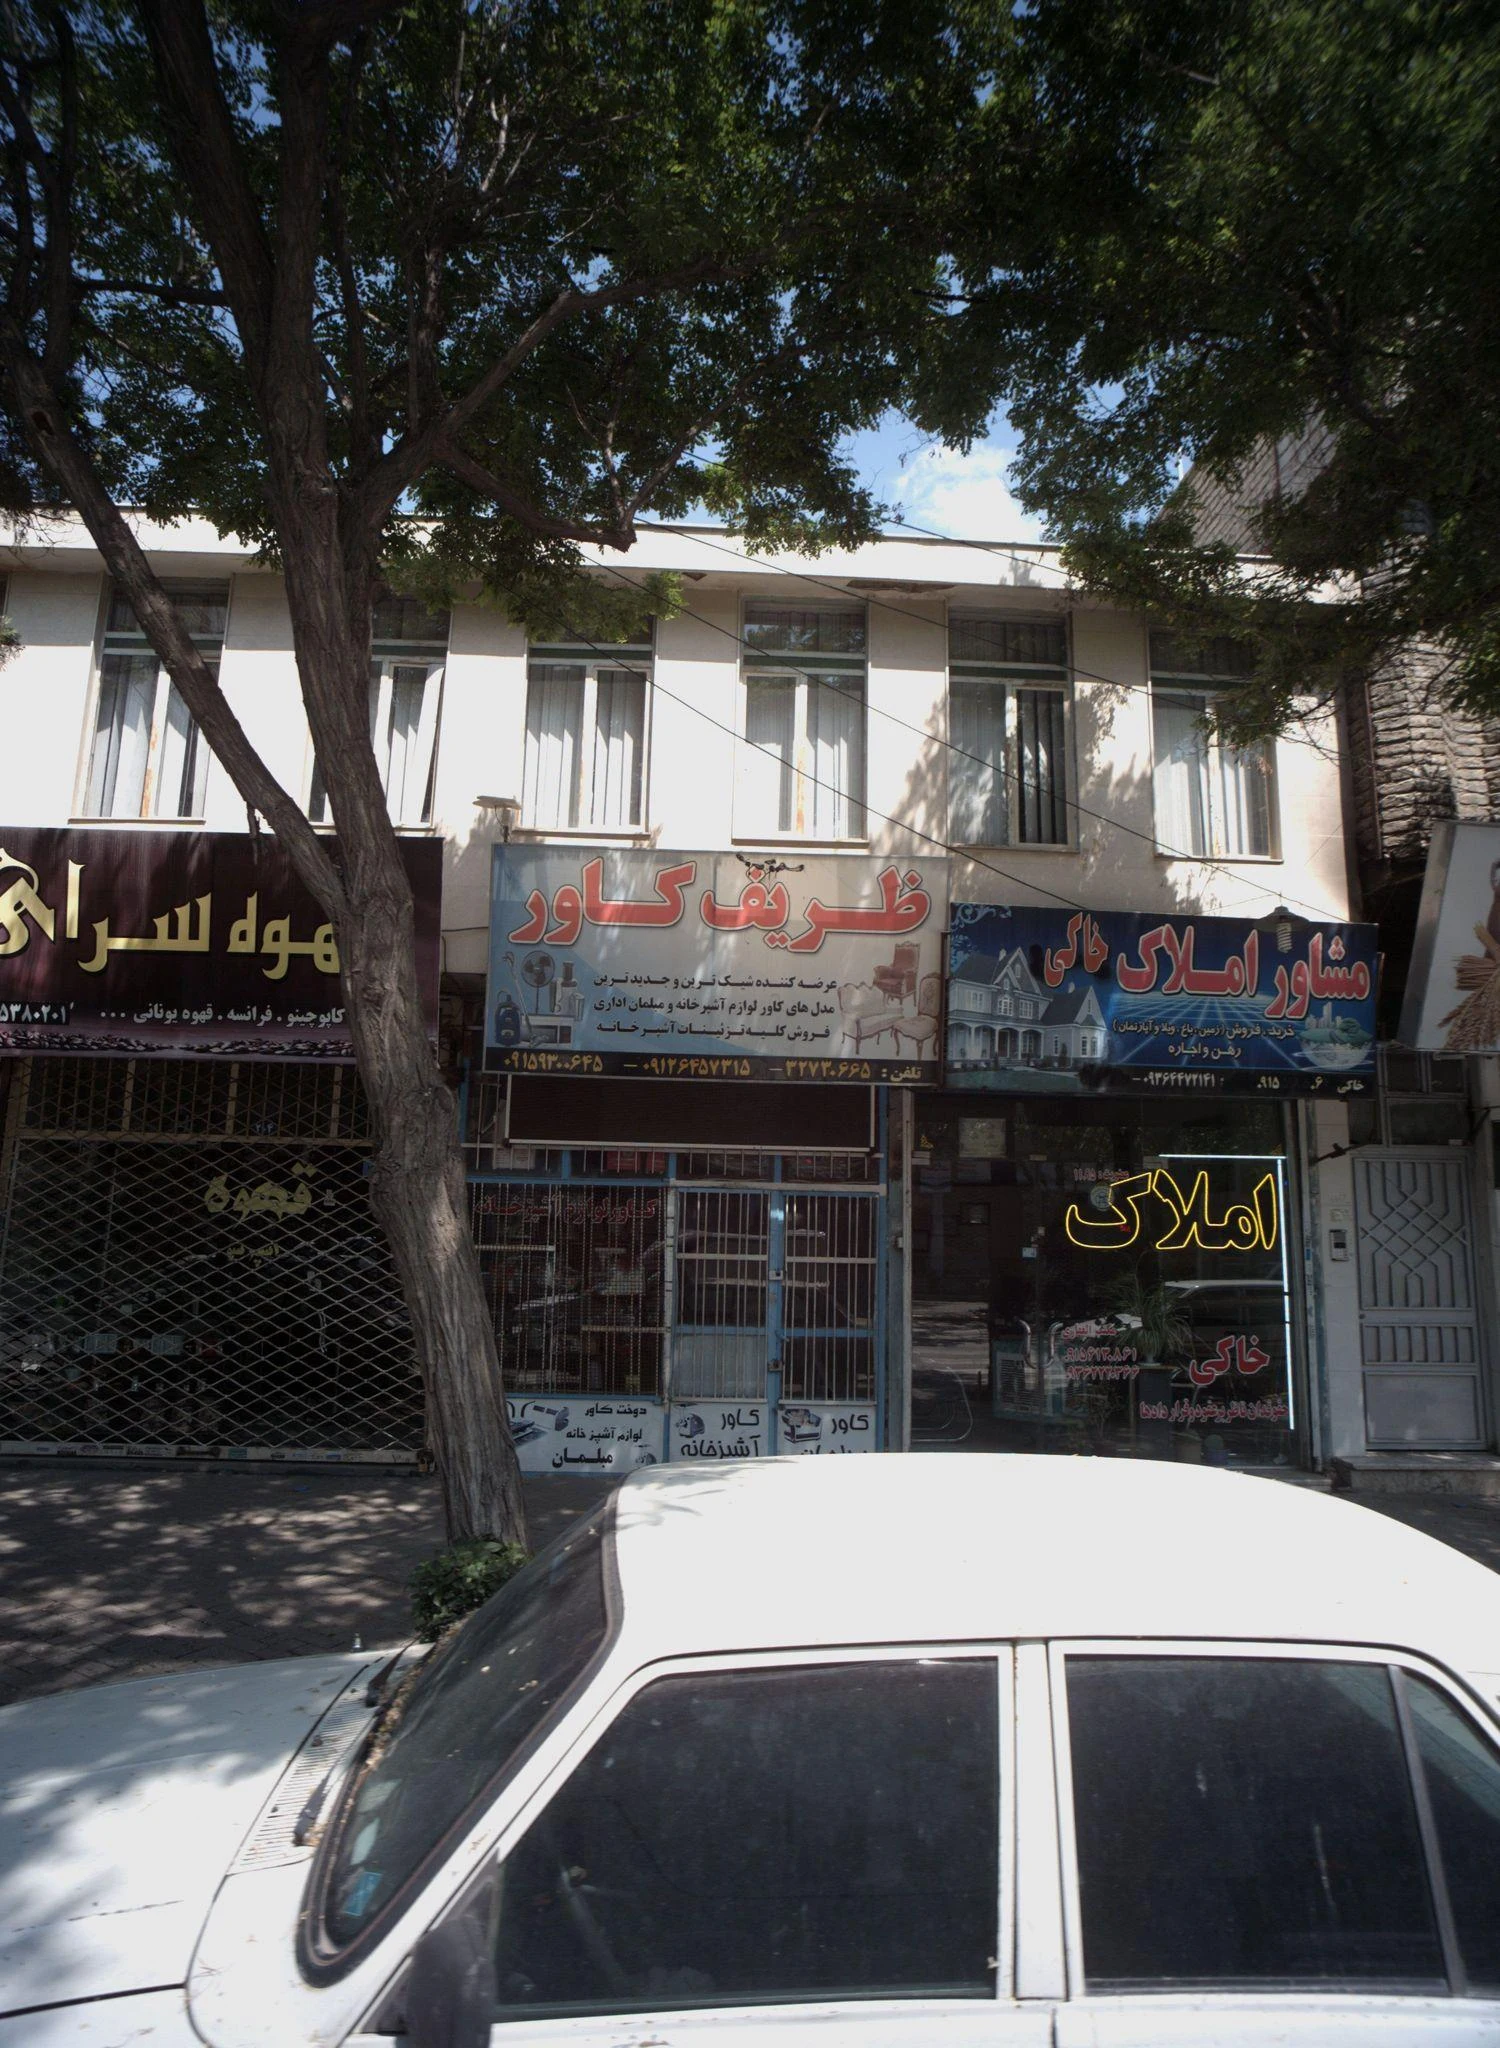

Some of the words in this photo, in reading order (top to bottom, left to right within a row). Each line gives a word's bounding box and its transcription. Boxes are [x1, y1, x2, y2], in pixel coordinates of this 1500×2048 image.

[508, 856, 697, 946] کاور
[700, 864, 932, 954] ظریف
[226, 890, 341, 980] هوه
[1044, 911, 1109, 988] خاکی
[1116, 922, 1260, 996] املاک
[593, 972, 629, 988] ترین
[673, 978, 679, 989] و
[681, 973, 716, 990] ترین
[718, 975, 753, 988] شیک
[756, 976, 795, 989] کننده
[1263, 931, 1371, 1020] مشاور
[798, 977, 837, 993] عرضه
[593, 996, 626, 1012] اداری
[629, 997, 665, 1014] مبلمان
[667, 1002, 673, 1014] و
[728, 999, 757, 1016] لوازم
[761, 999, 784, 1015] کاور
[786, 999, 808, 1016] های
[811, 1001, 835, 1016] مدل
[133, 1003, 177, 1024] یونانی
[182, 1003, 214, 1024] قهوه
[227, 1004, 272, 1027] فرانسه
[286, 1007, 346, 1028] کاپوچینو
[746, 1024, 786, 1038] کلیه
[788, 1026, 831, 1042] فروش
[1226, 1023, 1261, 1039] فروش
[1268, 1024, 1295, 1039] خرید
[1168, 1042, 1201, 1057] اجاره
[1211, 1045, 1242, 1059] رهن
[1336, 1079, 1365, 1094] خاکی
[1065, 1168, 1278, 1250] املاک
[1188, 1335, 1271, 1386] خاکی
[585, 1402, 613, 1417] کاور
[617, 1403, 647, 1418] دوخت
[721, 1408, 760, 1430] کاور
[831, 1414, 870, 1434] کاور
[617, 1428, 643, 1441] لوازم
[552, 1447, 613, 1468] مبلمان
